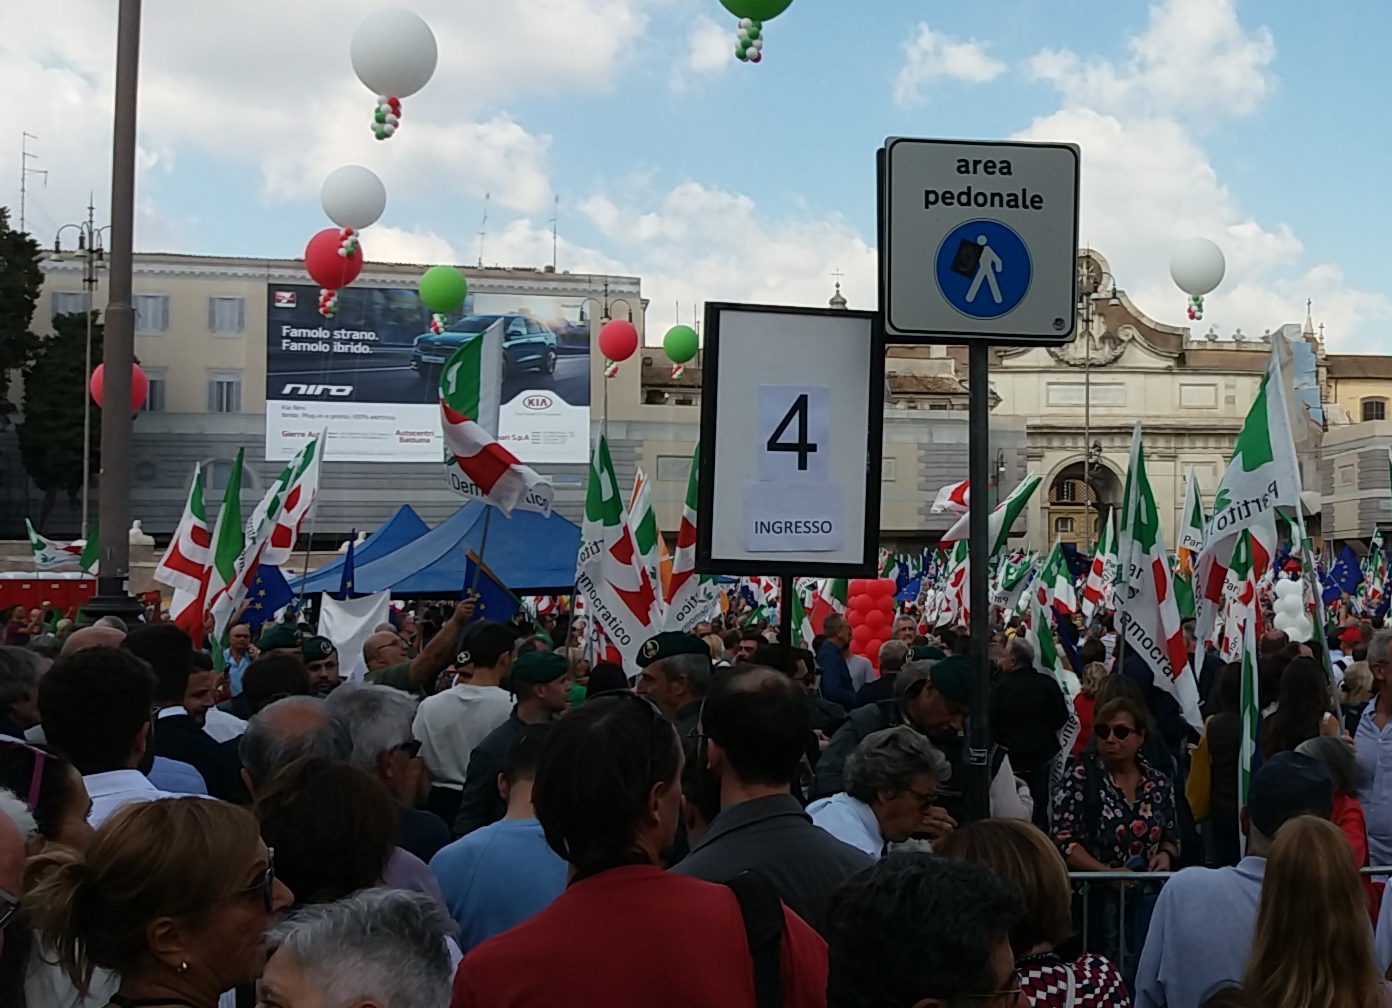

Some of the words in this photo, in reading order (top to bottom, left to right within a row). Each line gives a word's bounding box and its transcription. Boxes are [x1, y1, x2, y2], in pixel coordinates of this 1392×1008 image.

[956, 158, 1013, 176] area
[924, 185, 1044, 211] pedonale
[281, 325, 331, 339] Famolo
[333, 328, 379, 341] strano.
[281, 339, 331, 353] Famolo
[333, 341, 373, 354] ibrido.
[527, 398, 548, 407] KIA
[395, 429, 435, 437] Autocentri
[767, 393, 818, 471] 4
[754, 520, 833, 535] INGRESSO
[1183, 535, 1202, 549] Par
[578, 571, 631, 646] emocratico
